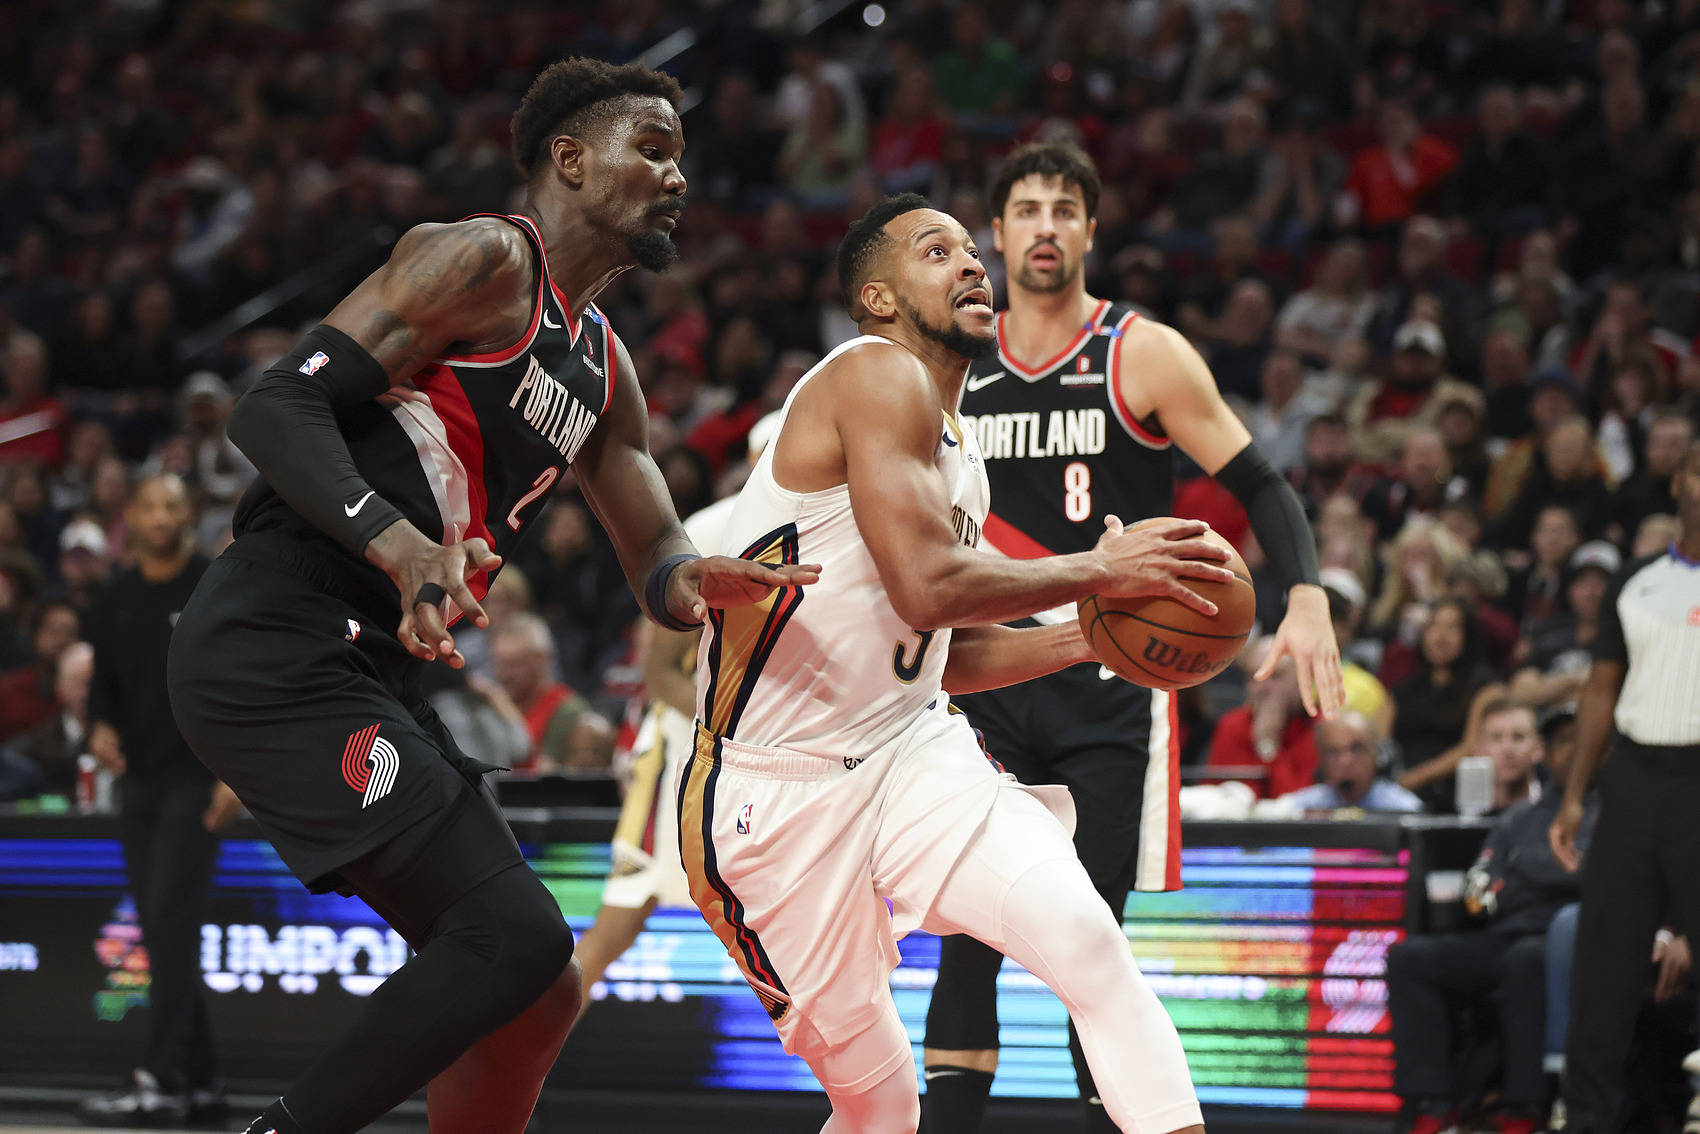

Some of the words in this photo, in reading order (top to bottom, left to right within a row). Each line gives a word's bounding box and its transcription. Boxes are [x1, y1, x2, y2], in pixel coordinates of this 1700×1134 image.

[509, 353, 598, 465] PORTLAND
[506, 465, 559, 532] 2
[1064, 461, 1092, 523] 8
[1143, 635, 1230, 675] Wilso
